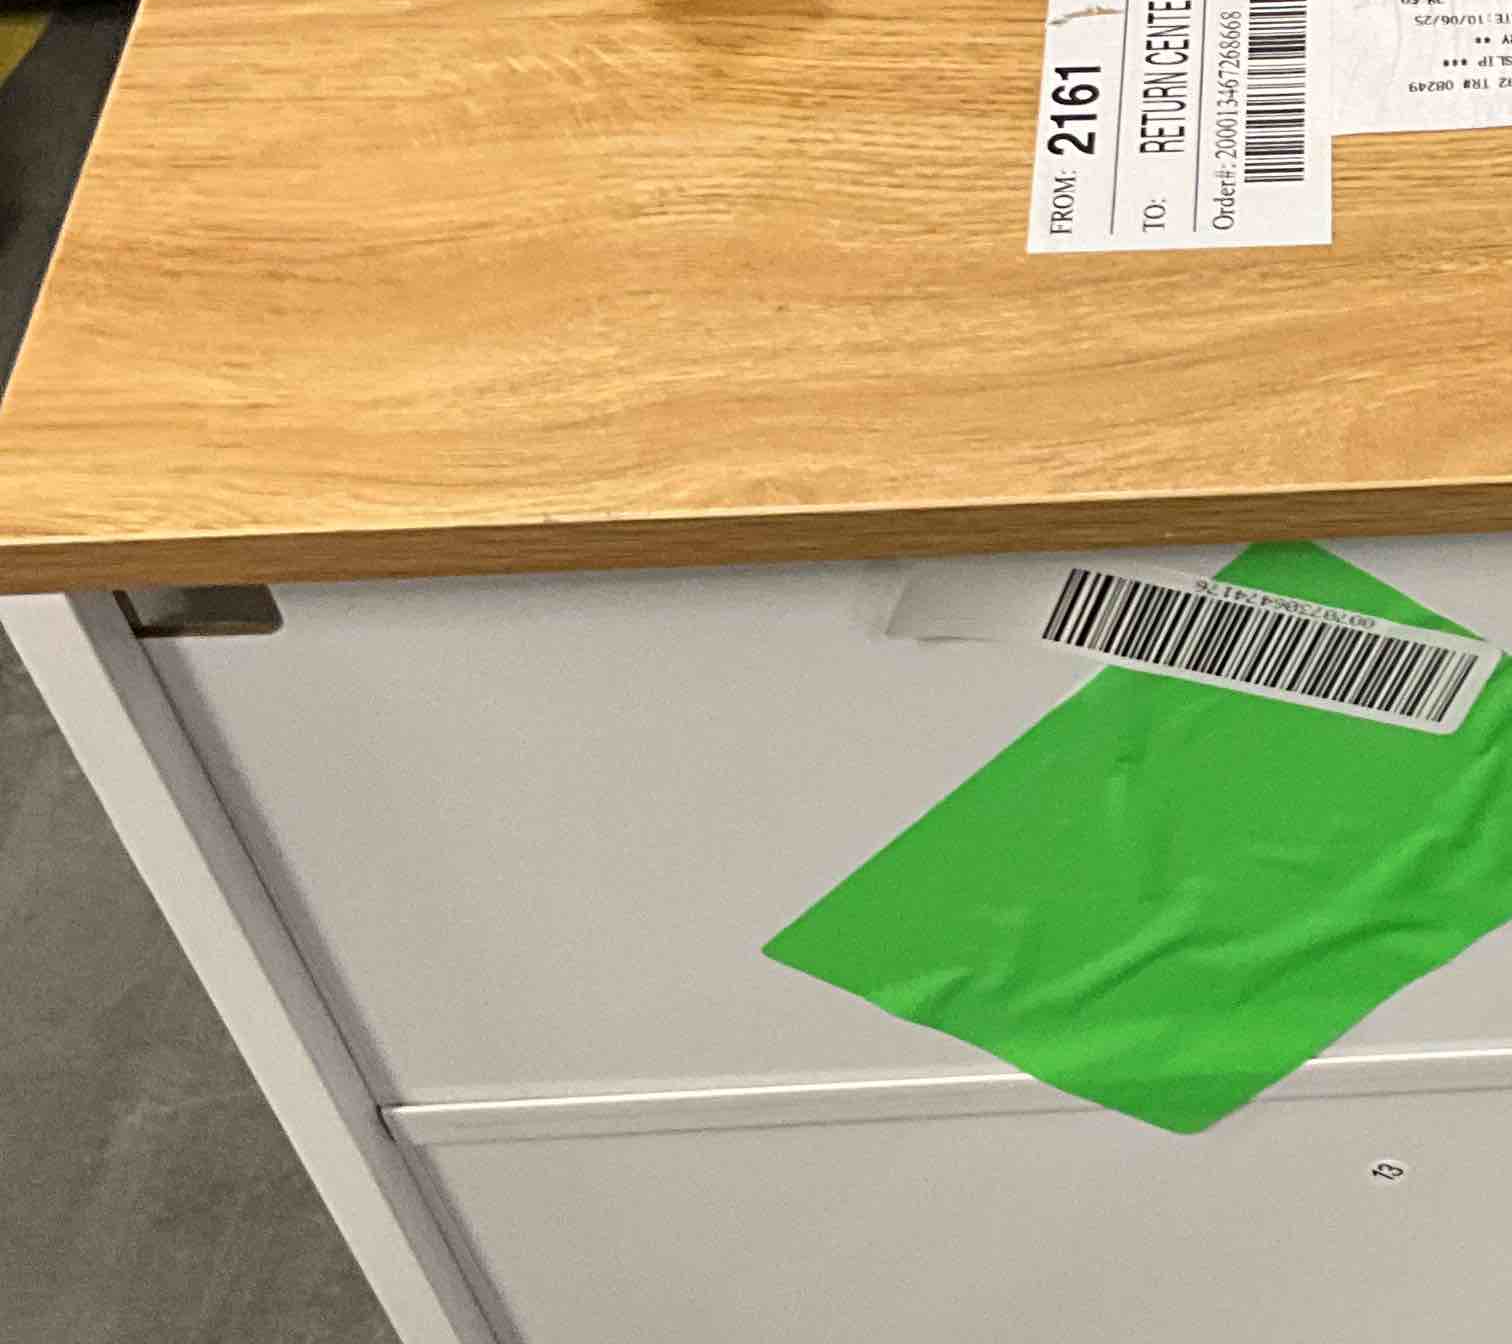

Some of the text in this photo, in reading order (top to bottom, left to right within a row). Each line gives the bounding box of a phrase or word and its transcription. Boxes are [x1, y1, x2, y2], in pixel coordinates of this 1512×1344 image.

[1478, 56, 1512, 66] SLIP
[1408, 80, 1454, 92] 08249
[1464, 79, 1488, 89] TR#
[1140, 71, 1188, 153] RETURN
[1212, 11, 1241, 229] Order#: 200013467268668
[1047, 66, 1101, 234] FROM: 2161
[1143, 198, 1166, 231] TO:
